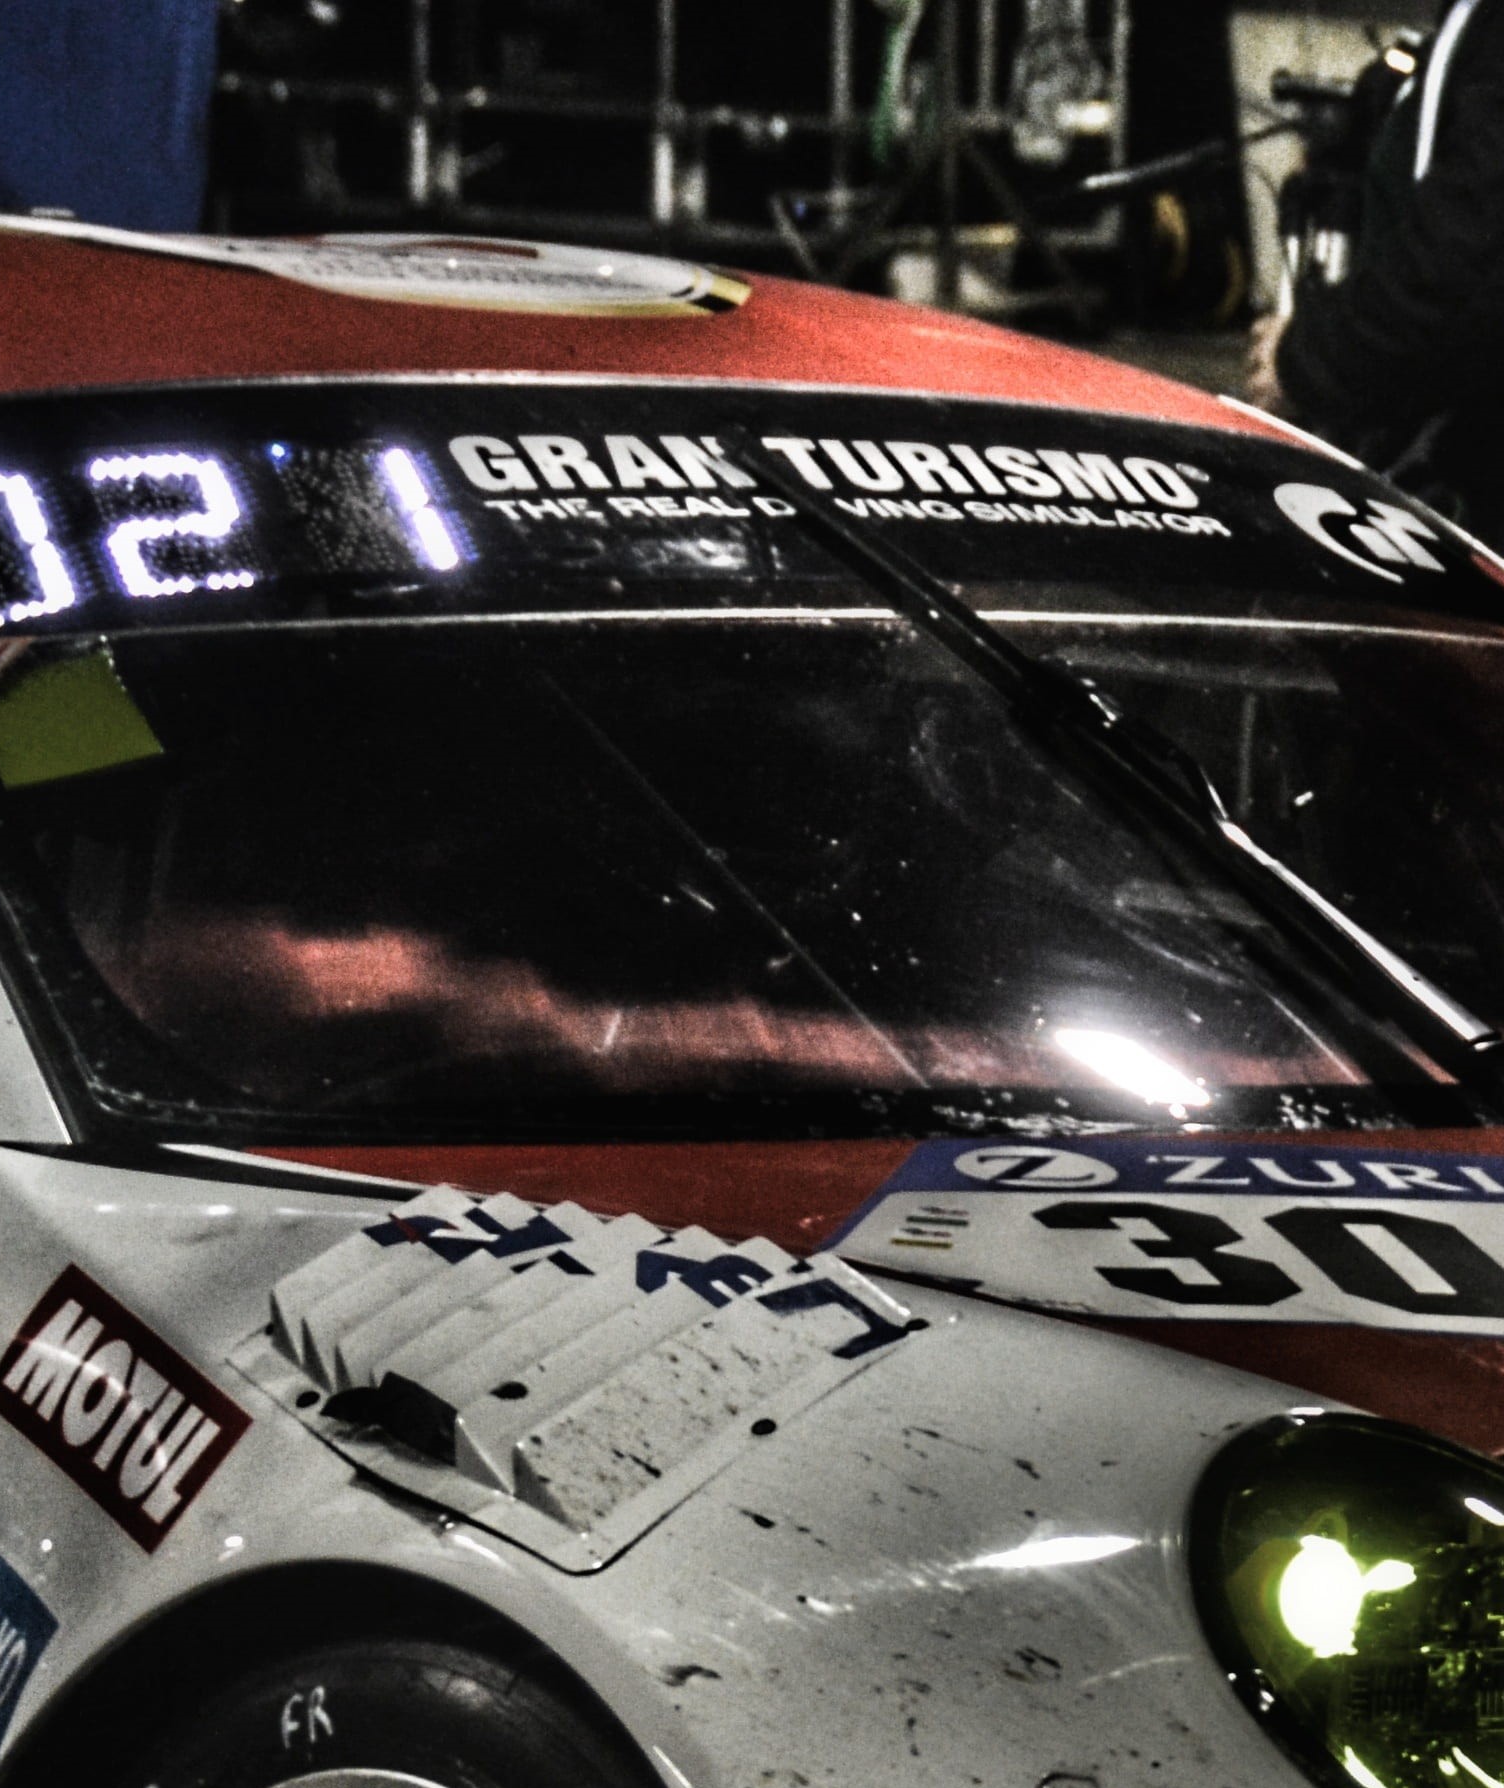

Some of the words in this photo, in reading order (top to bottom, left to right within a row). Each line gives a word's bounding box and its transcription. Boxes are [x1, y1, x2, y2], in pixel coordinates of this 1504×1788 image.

[447, 434, 758, 491] GRAN
[760, 436, 1202, 510] TURISMO
[483, 499, 603, 522] THE
[607, 495, 752, 519] REAL
[751, 496, 965, 522] DVING
[961, 501, 1233, 538] SIMULATOR
[4, 1294, 223, 1525] MOTUL
[280, 1684, 334, 1749] FR
